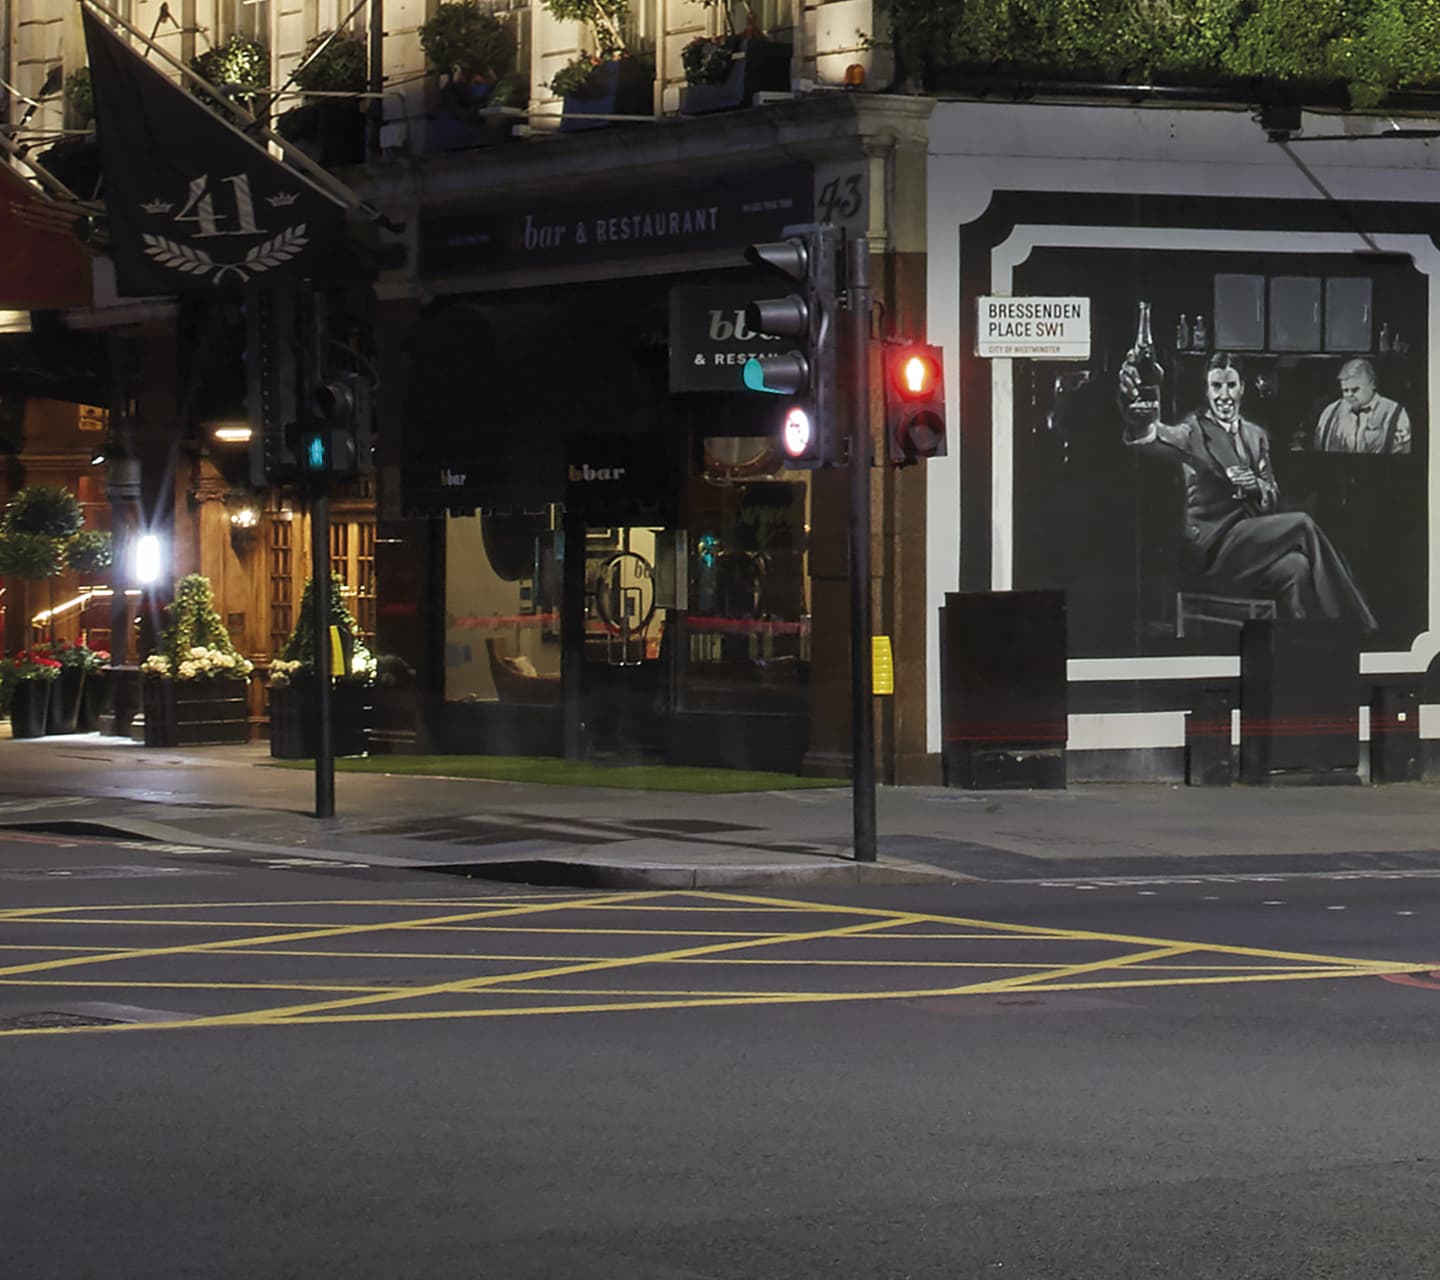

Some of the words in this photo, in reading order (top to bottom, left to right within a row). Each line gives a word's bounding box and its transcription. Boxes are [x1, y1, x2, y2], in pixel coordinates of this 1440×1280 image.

[174, 172, 269, 238] 41
[576, 221, 589, 245] &
[596, 206, 719, 241] RESTAURANT
[988, 304, 1081, 319] BRESSENDEN
[988, 322, 1032, 337] PLACE
[1035, 322, 1064, 337] SW1
[694, 352, 707, 366] &
